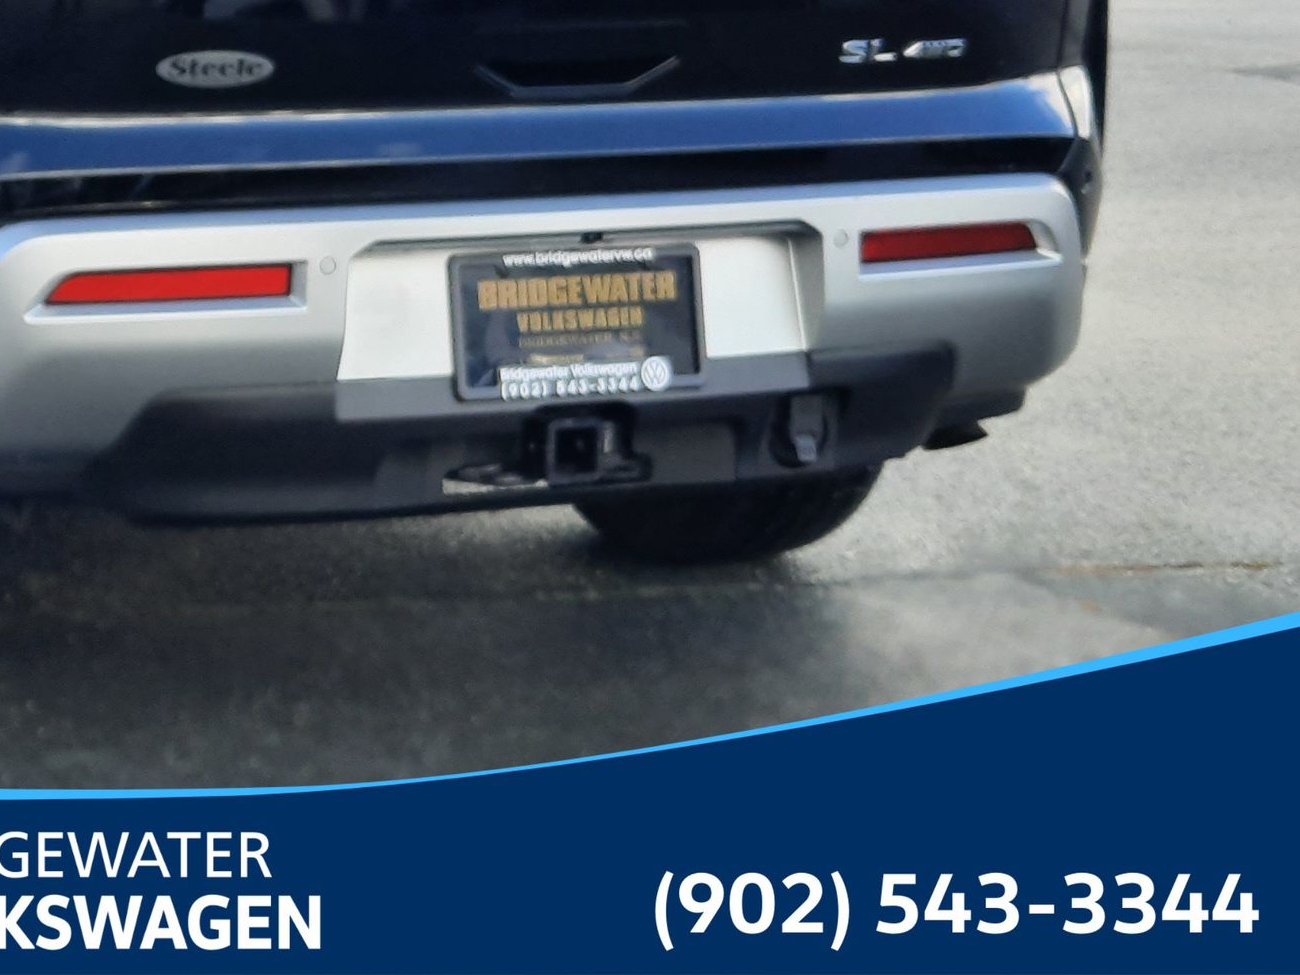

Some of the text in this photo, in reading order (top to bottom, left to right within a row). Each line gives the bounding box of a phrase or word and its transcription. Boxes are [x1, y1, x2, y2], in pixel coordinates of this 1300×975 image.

[839, 38, 897, 63] SL
[169, 57, 264, 78] Steele
[503, 247, 653, 268] www.bridgewatervw.ca
[477, 271, 676, 310] BRIDGEWATER
[516, 305, 643, 333] VOLKSWAGEN
[500, 361, 638, 382] Bridgewater Volkswagen
[501, 375, 641, 401] (902) 543-3344
